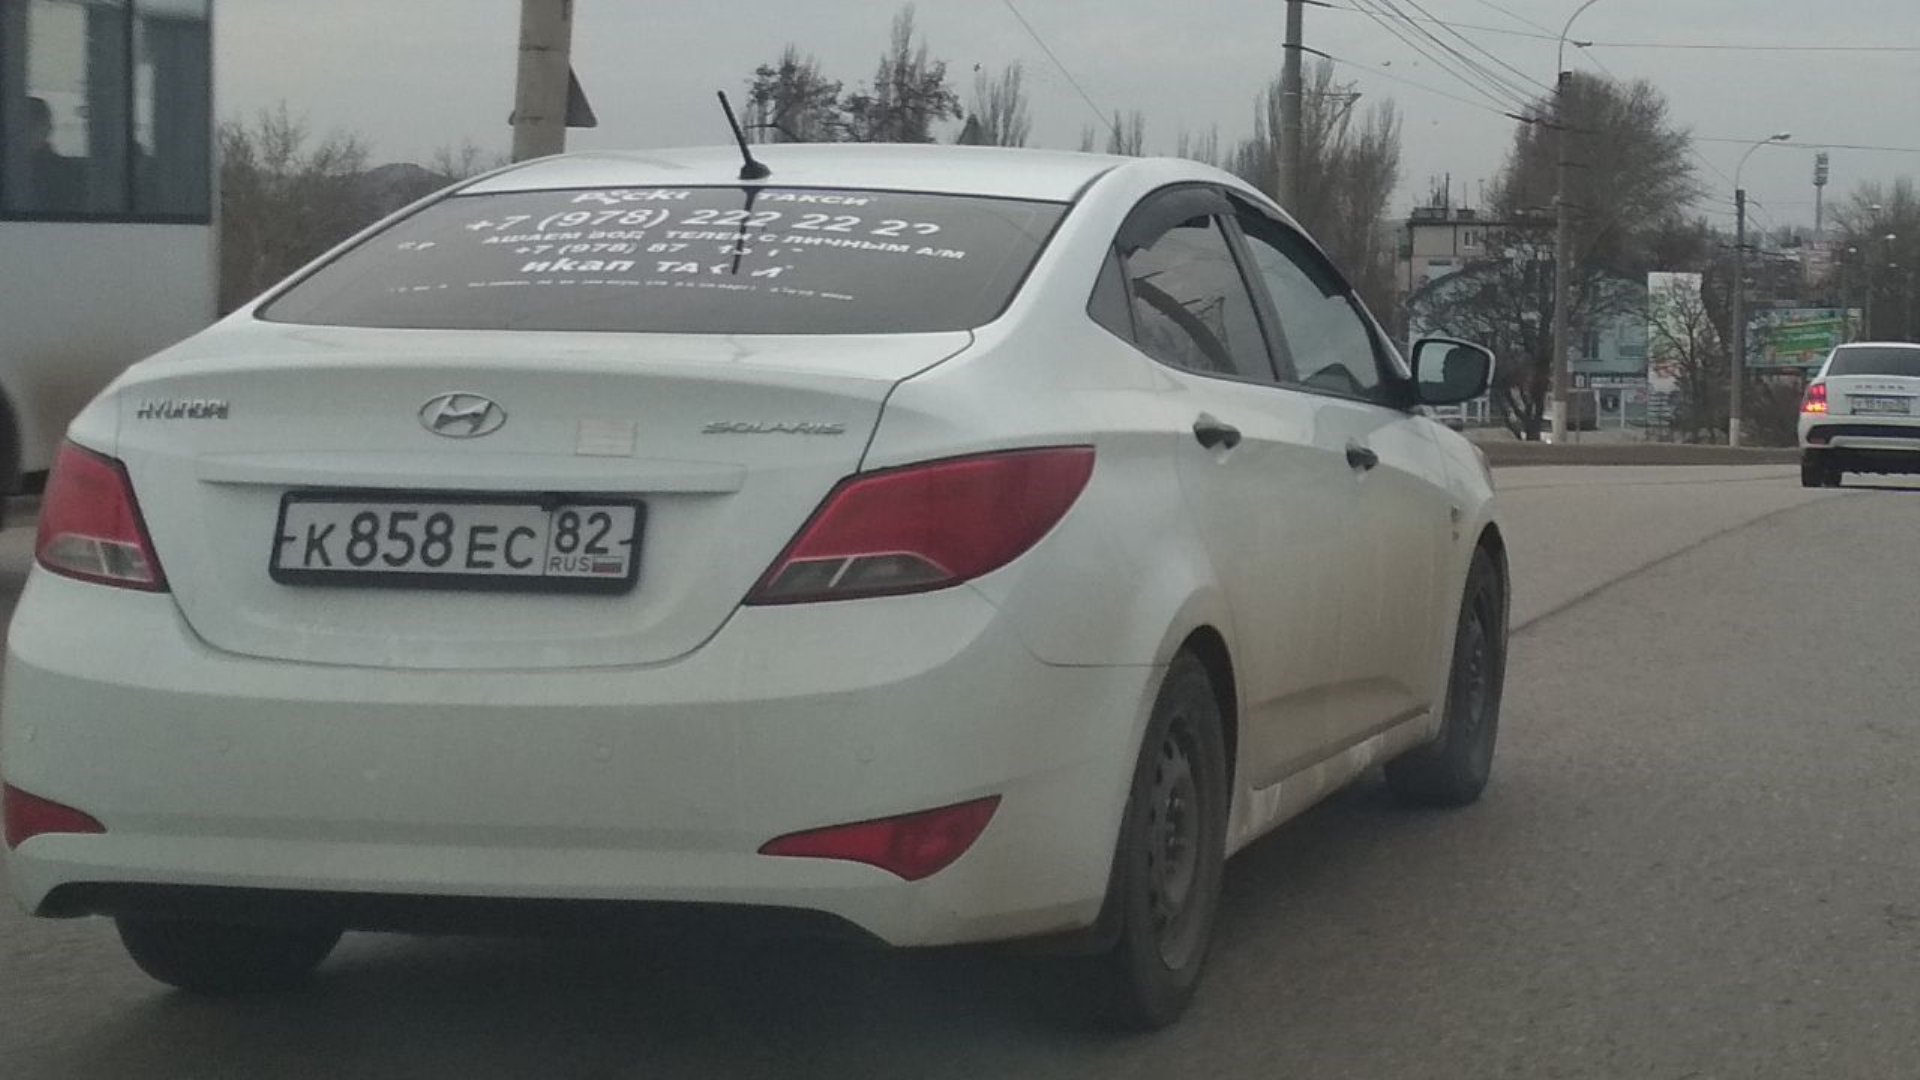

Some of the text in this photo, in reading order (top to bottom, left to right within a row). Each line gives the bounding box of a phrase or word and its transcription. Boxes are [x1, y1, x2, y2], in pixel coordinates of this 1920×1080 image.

[757, 192, 869, 206] ТАКСИ
[465, 214, 531, 231] +7
[537, 208, 670, 231] (978)
[681, 209, 782, 227] 222
[791, 213, 861, 232] 22
[782, 234, 910, 252] ЛИЧНЫМ
[137, 400, 229, 420] HYUNDAI
[701, 421, 846, 435] SOLARIS
[554, 510, 612, 555] 82
[550, 556, 590, 573] RUS
